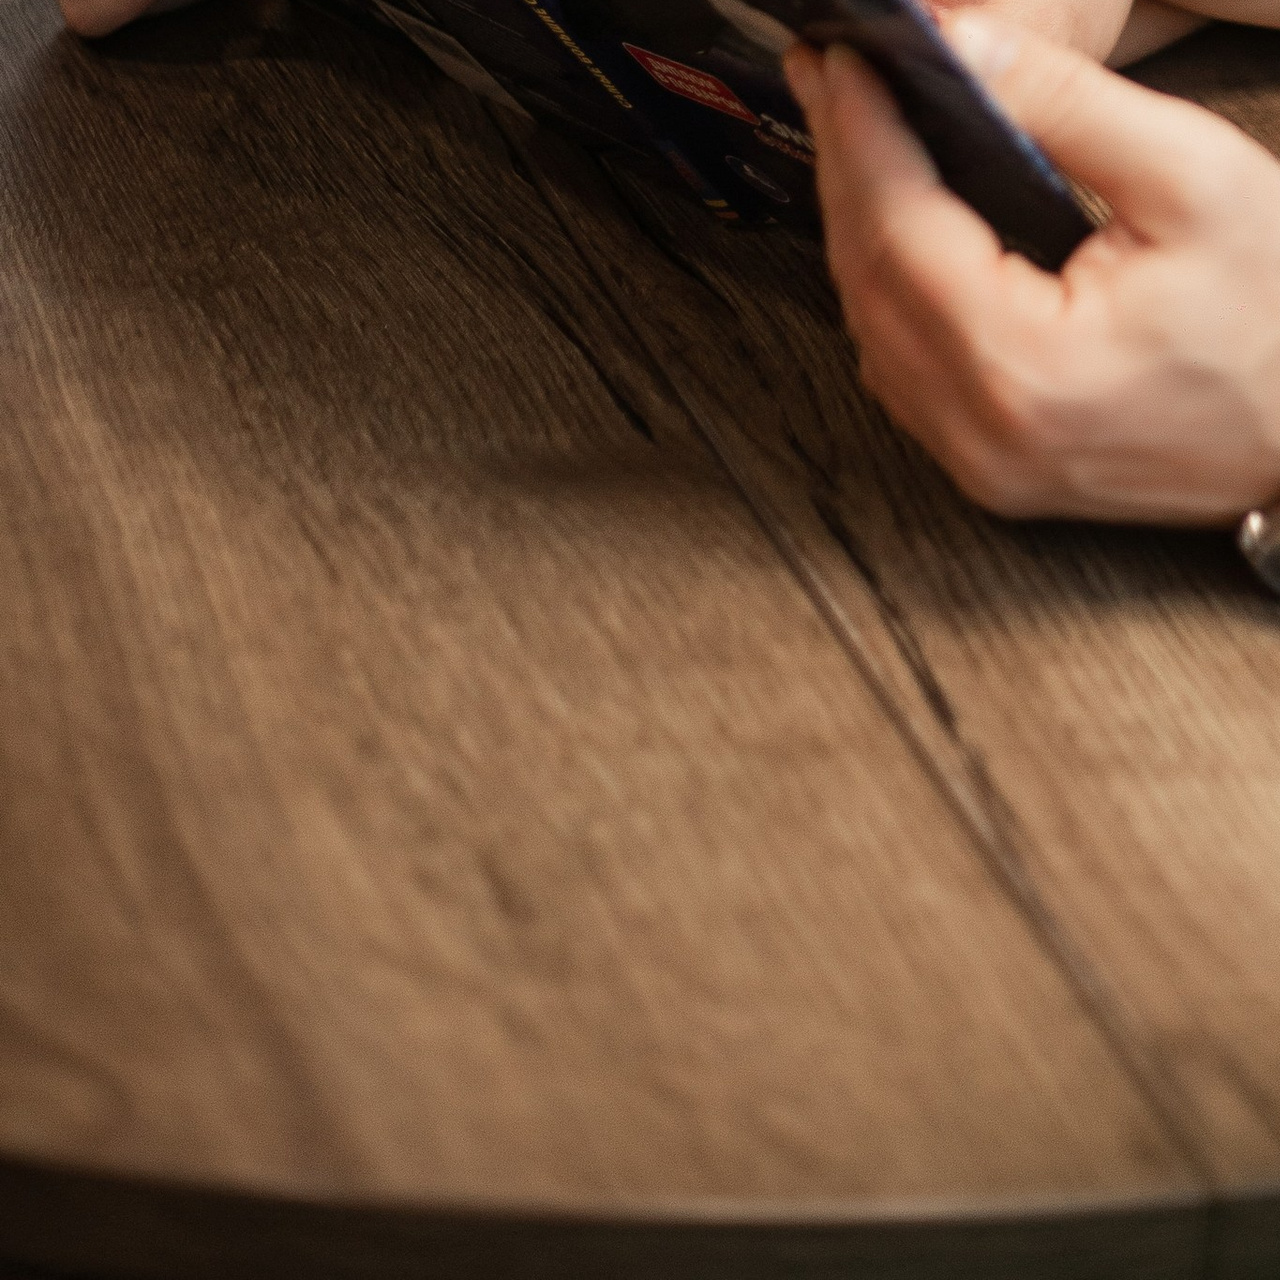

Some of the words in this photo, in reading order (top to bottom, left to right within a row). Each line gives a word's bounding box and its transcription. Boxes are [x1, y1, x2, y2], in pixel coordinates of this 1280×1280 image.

[536, 8, 594, 65] БОЛЬШИЕ
[588, 65, 634, 109] САМЫЕ
[646, 57, 720, 93] ДИПЛОМ
